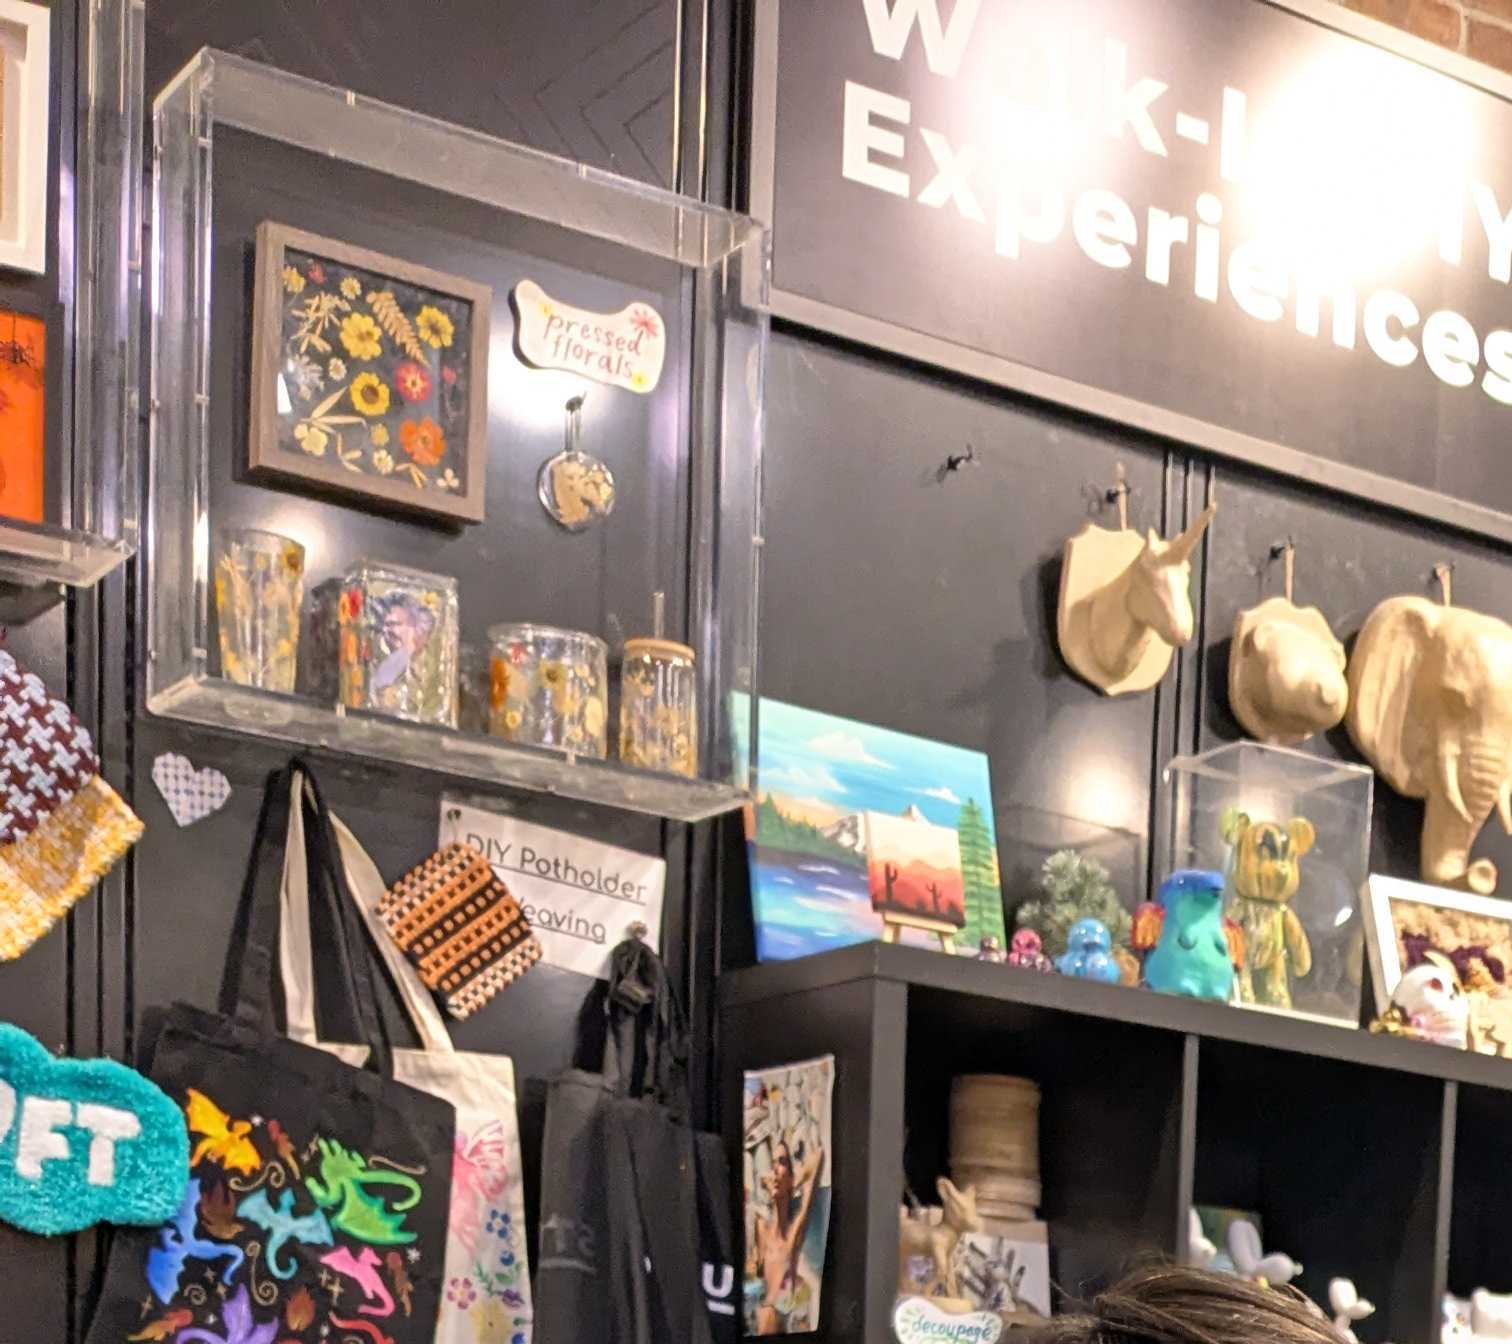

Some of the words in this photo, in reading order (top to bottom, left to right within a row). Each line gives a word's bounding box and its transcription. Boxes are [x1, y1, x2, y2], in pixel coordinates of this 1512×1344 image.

[544, 314, 644, 355] pressed
[552, 334, 633, 379] florals
[467, 833, 511, 864] DIY
[520, 847, 647, 899] Potholder
[519, 896, 607, 944] eaving
